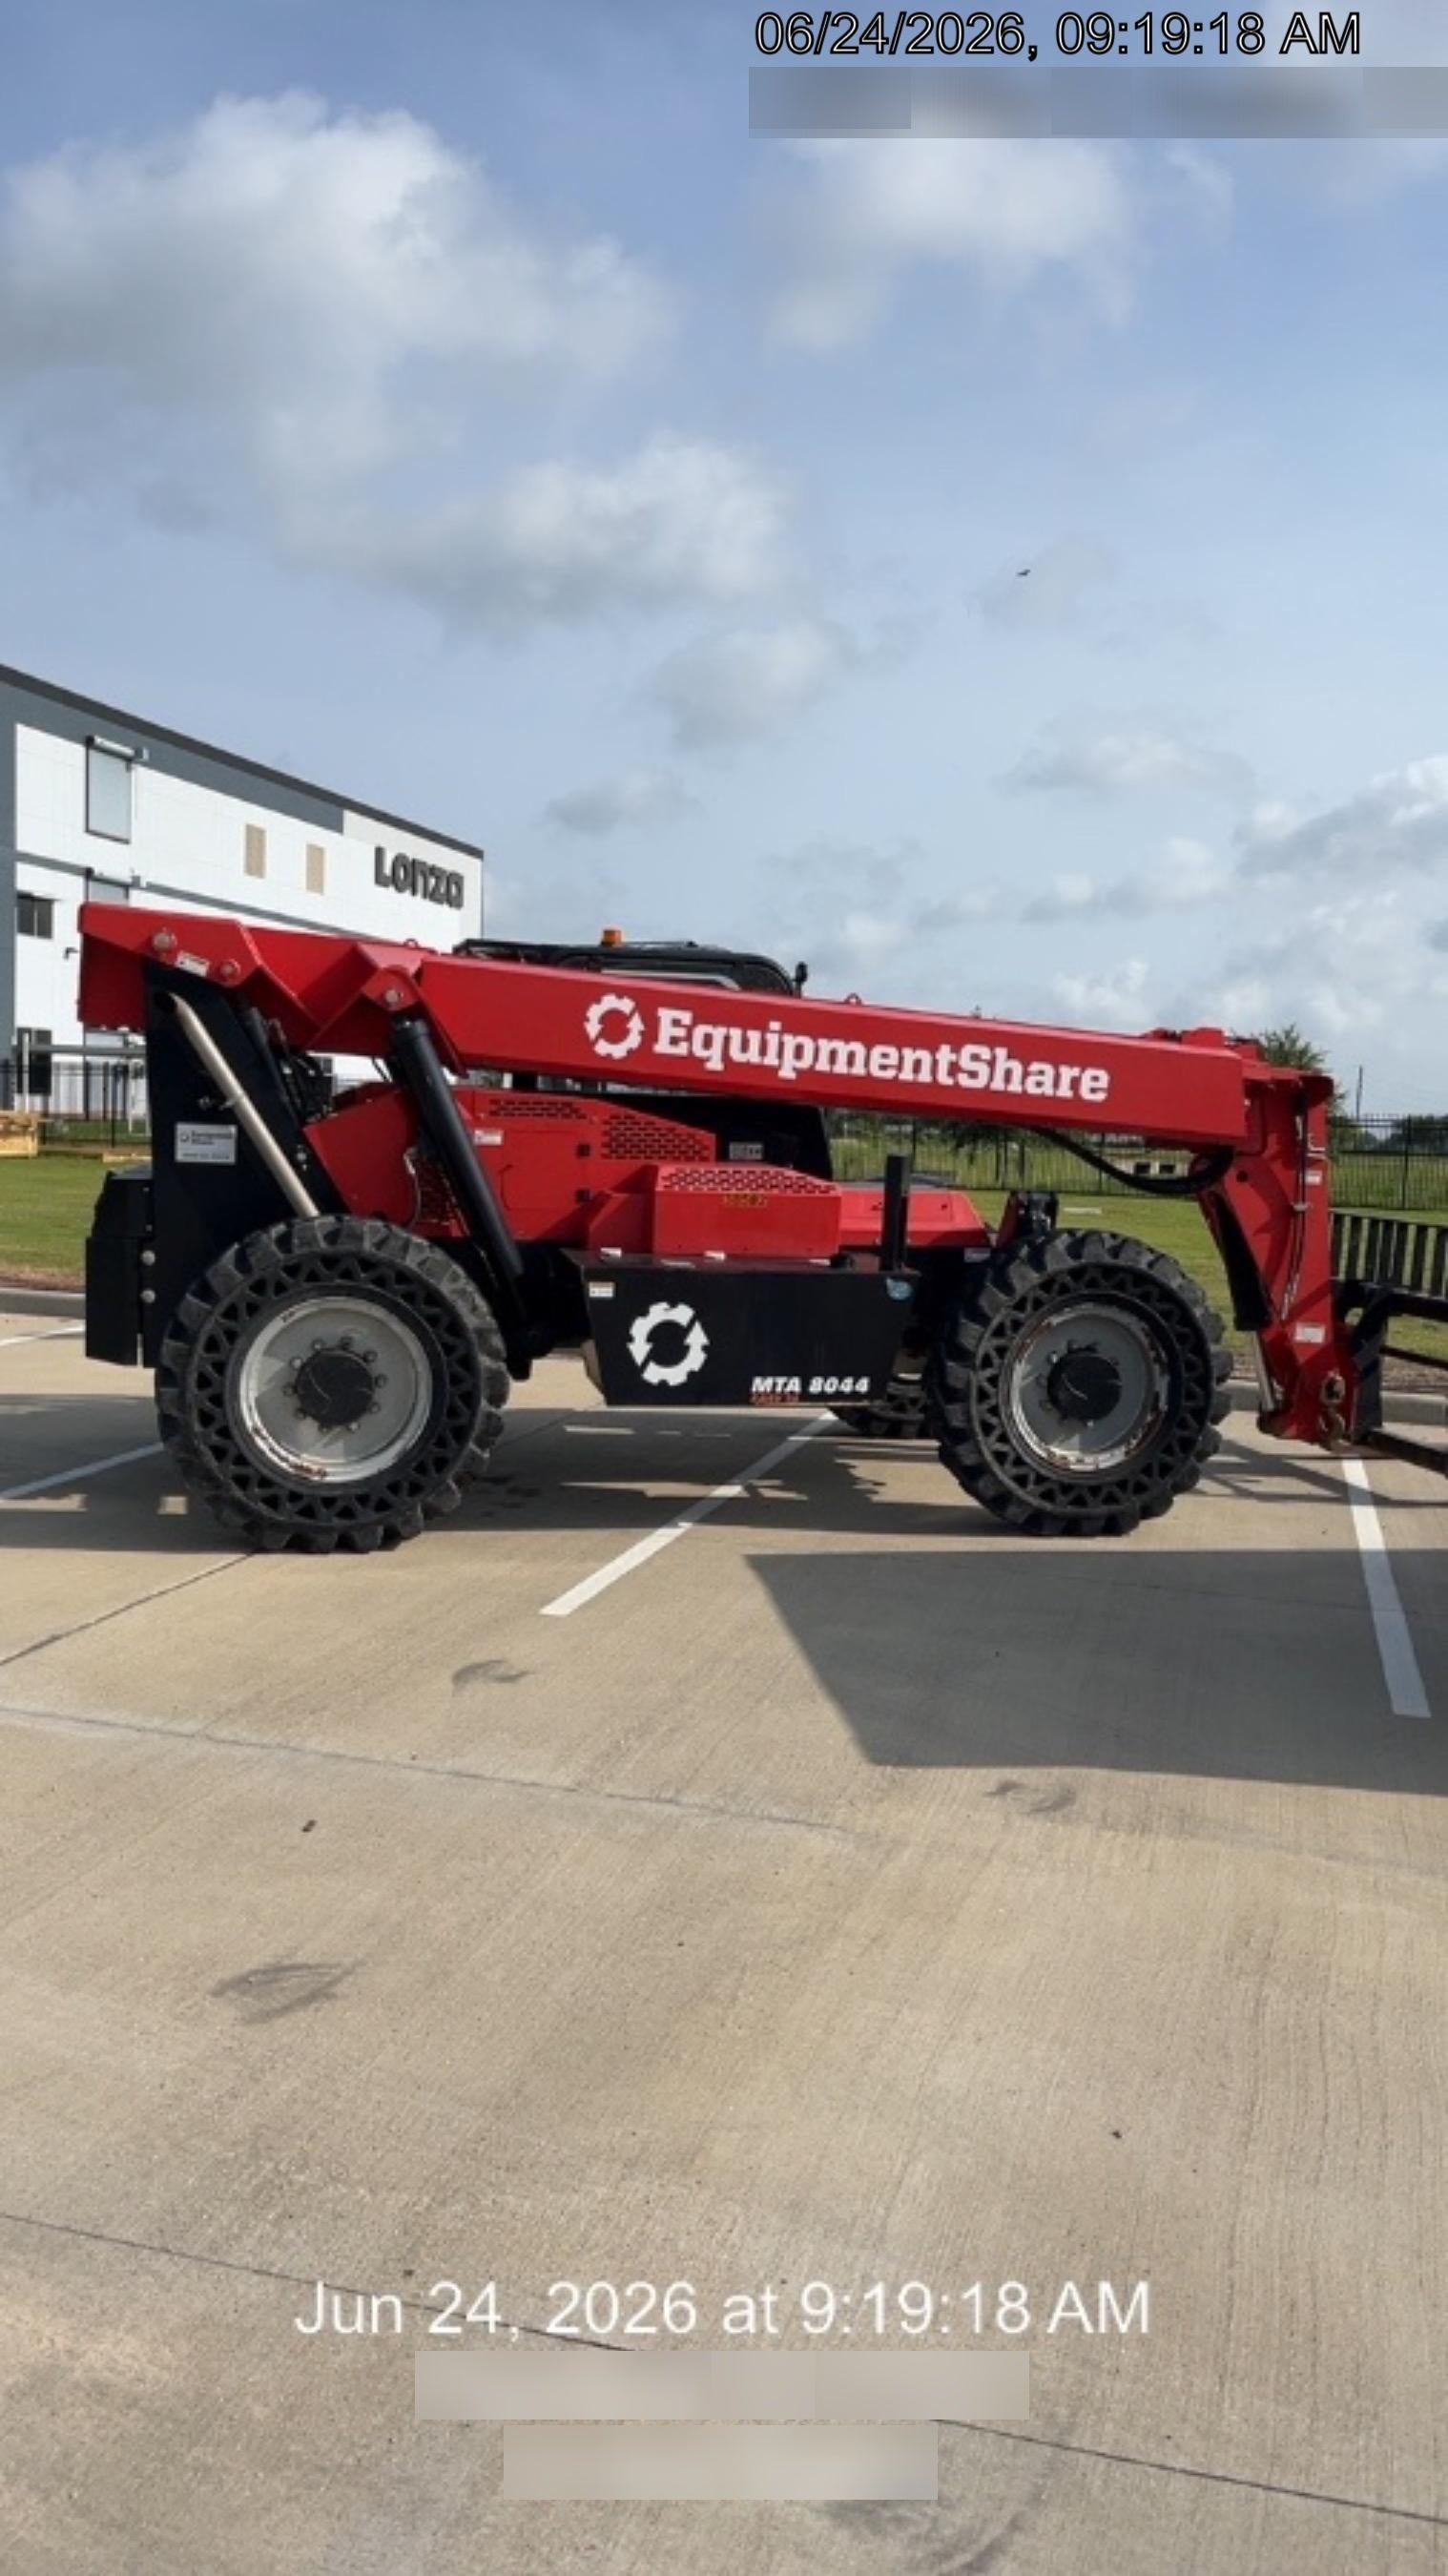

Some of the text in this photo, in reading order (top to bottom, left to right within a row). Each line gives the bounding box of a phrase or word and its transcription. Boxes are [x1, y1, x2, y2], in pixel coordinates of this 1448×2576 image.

[374, 845, 465, 910] Lonza
[654, 1007, 1109, 1102] EquipmentShare
[751, 1376, 870, 1394] MTA 8044
